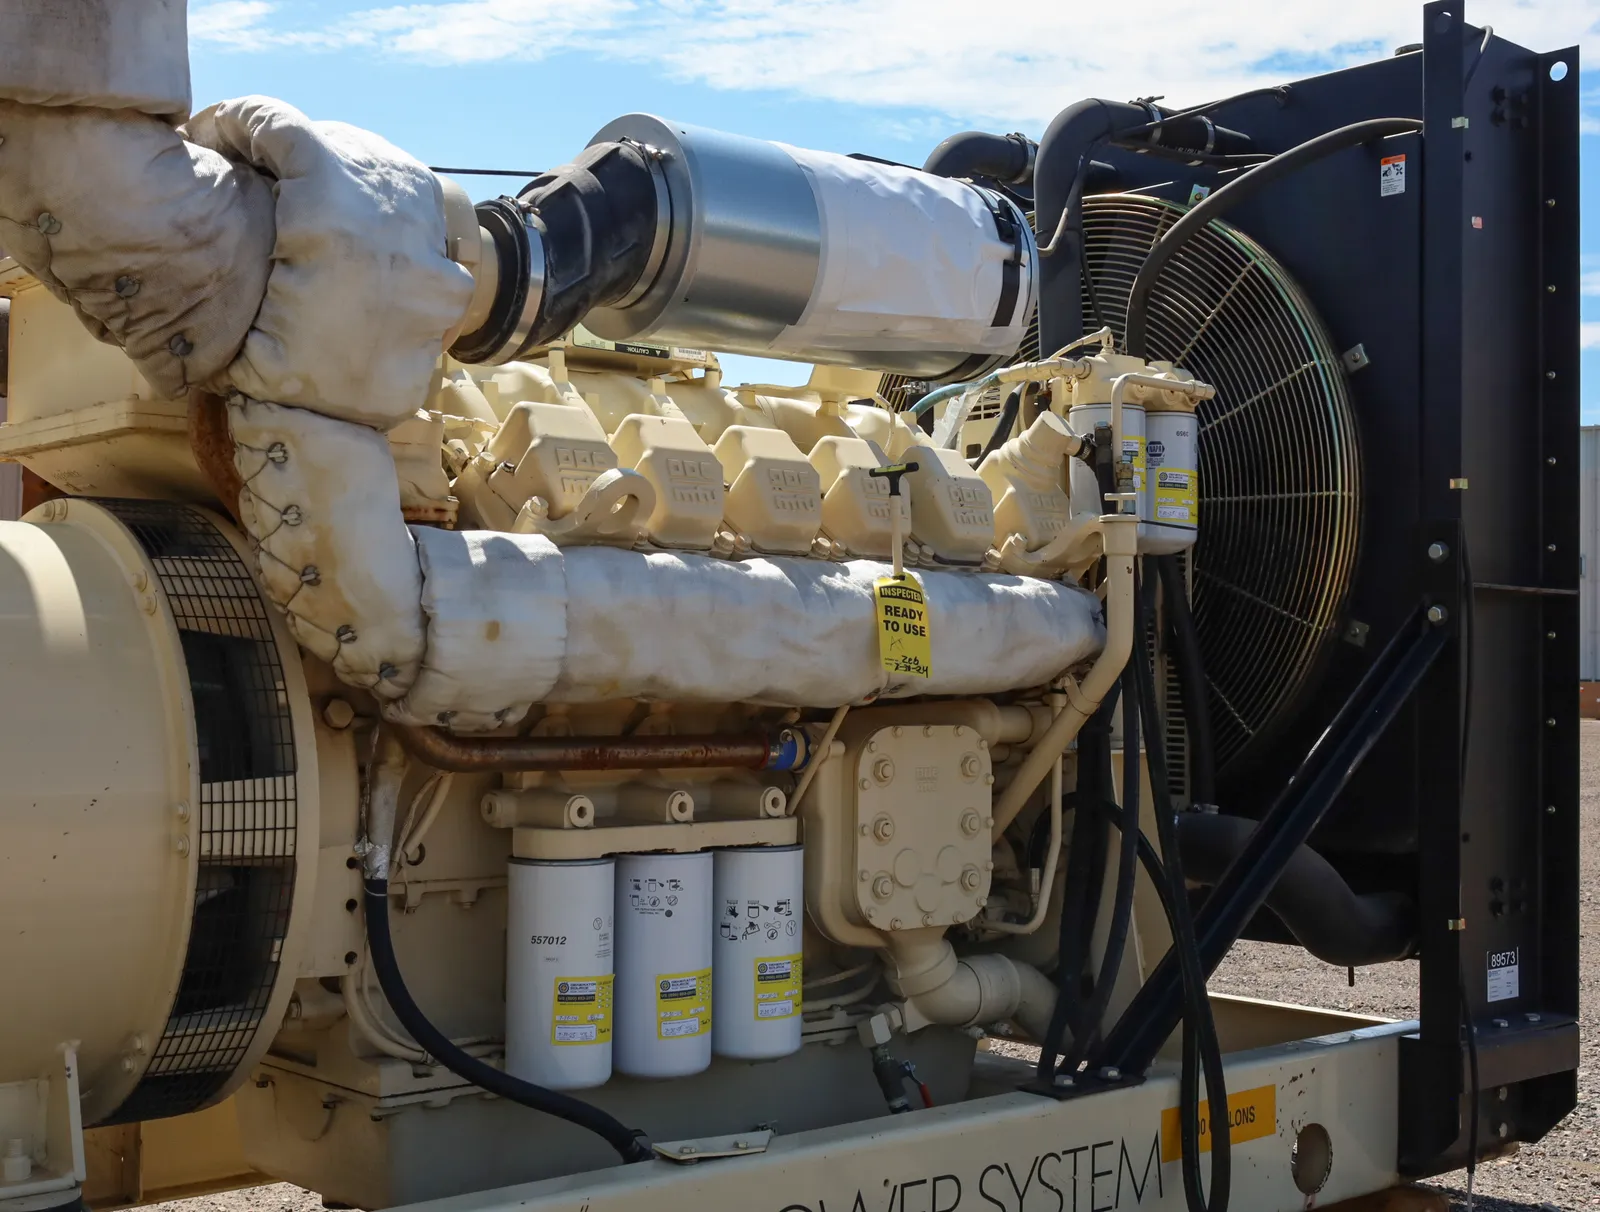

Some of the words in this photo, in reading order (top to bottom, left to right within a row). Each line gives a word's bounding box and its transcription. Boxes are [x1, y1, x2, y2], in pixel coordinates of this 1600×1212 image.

[1149, 445, 1162, 453] NAPA
[880, 586, 922, 602] INSPECTED
[884, 604, 923, 622] READY
[883, 619, 900, 632] TO
[903, 622, 926, 637] USE
[530, 935, 567, 945] 557012
[1491, 950, 1516, 968] 89573
[978, 1129, 1164, 1212] SYSTEM
